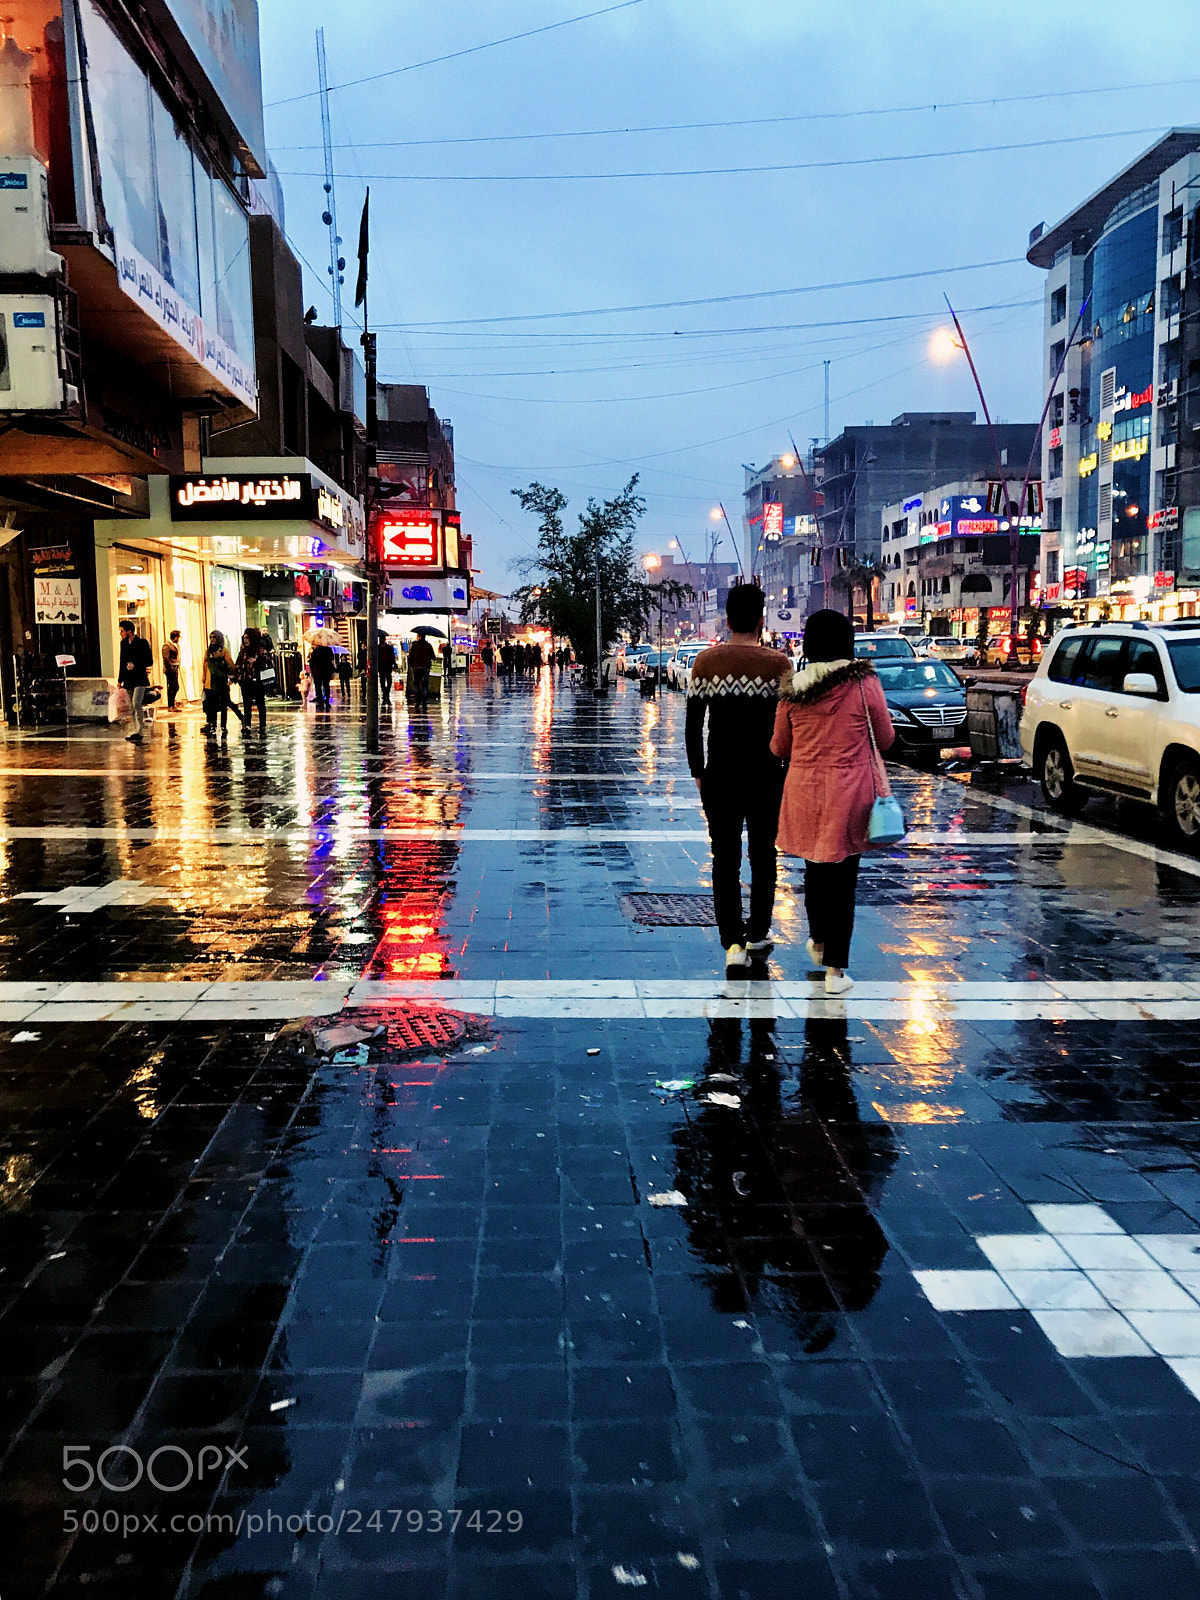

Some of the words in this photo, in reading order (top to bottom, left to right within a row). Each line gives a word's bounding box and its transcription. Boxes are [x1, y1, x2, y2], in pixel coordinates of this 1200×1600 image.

[178, 476, 240, 506] الأفضل
[241, 475, 301, 505] الأختيار
[40, 582, 50, 595] M
[54, 585, 61, 595] &
[65, 582, 74, 595] A
